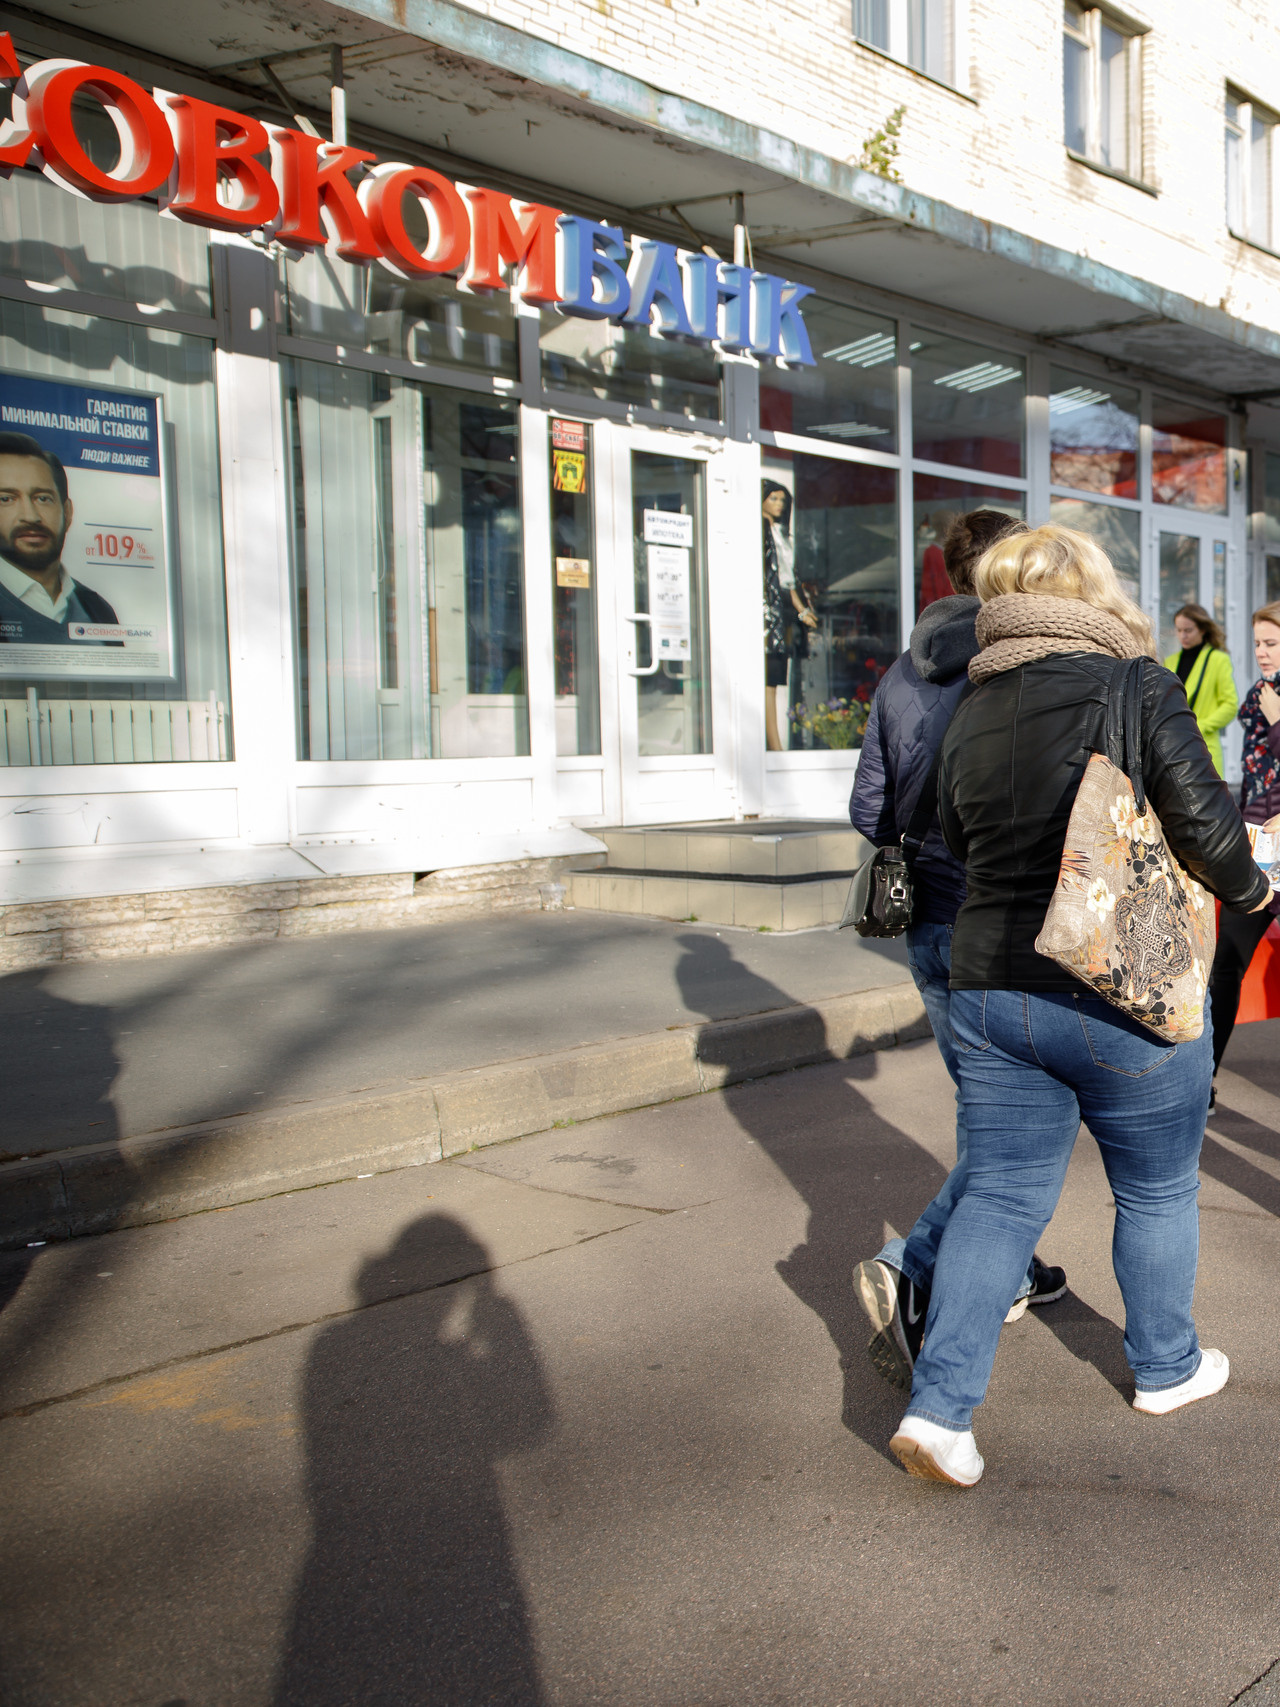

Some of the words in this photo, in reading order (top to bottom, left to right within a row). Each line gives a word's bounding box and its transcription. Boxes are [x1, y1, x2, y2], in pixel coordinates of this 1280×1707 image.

[87, 399, 148, 421] ГАРАНТИЯ
[2, 405, 99, 434] МИНИМАЛЬНОЙ
[102, 420, 148, 441] СТАВКИ
[81, 448, 110, 463] ЛЮДИ
[111, 452, 150, 468] ВАЖНЕЕ
[87, 627, 152, 637] СОВКОМБАНК
